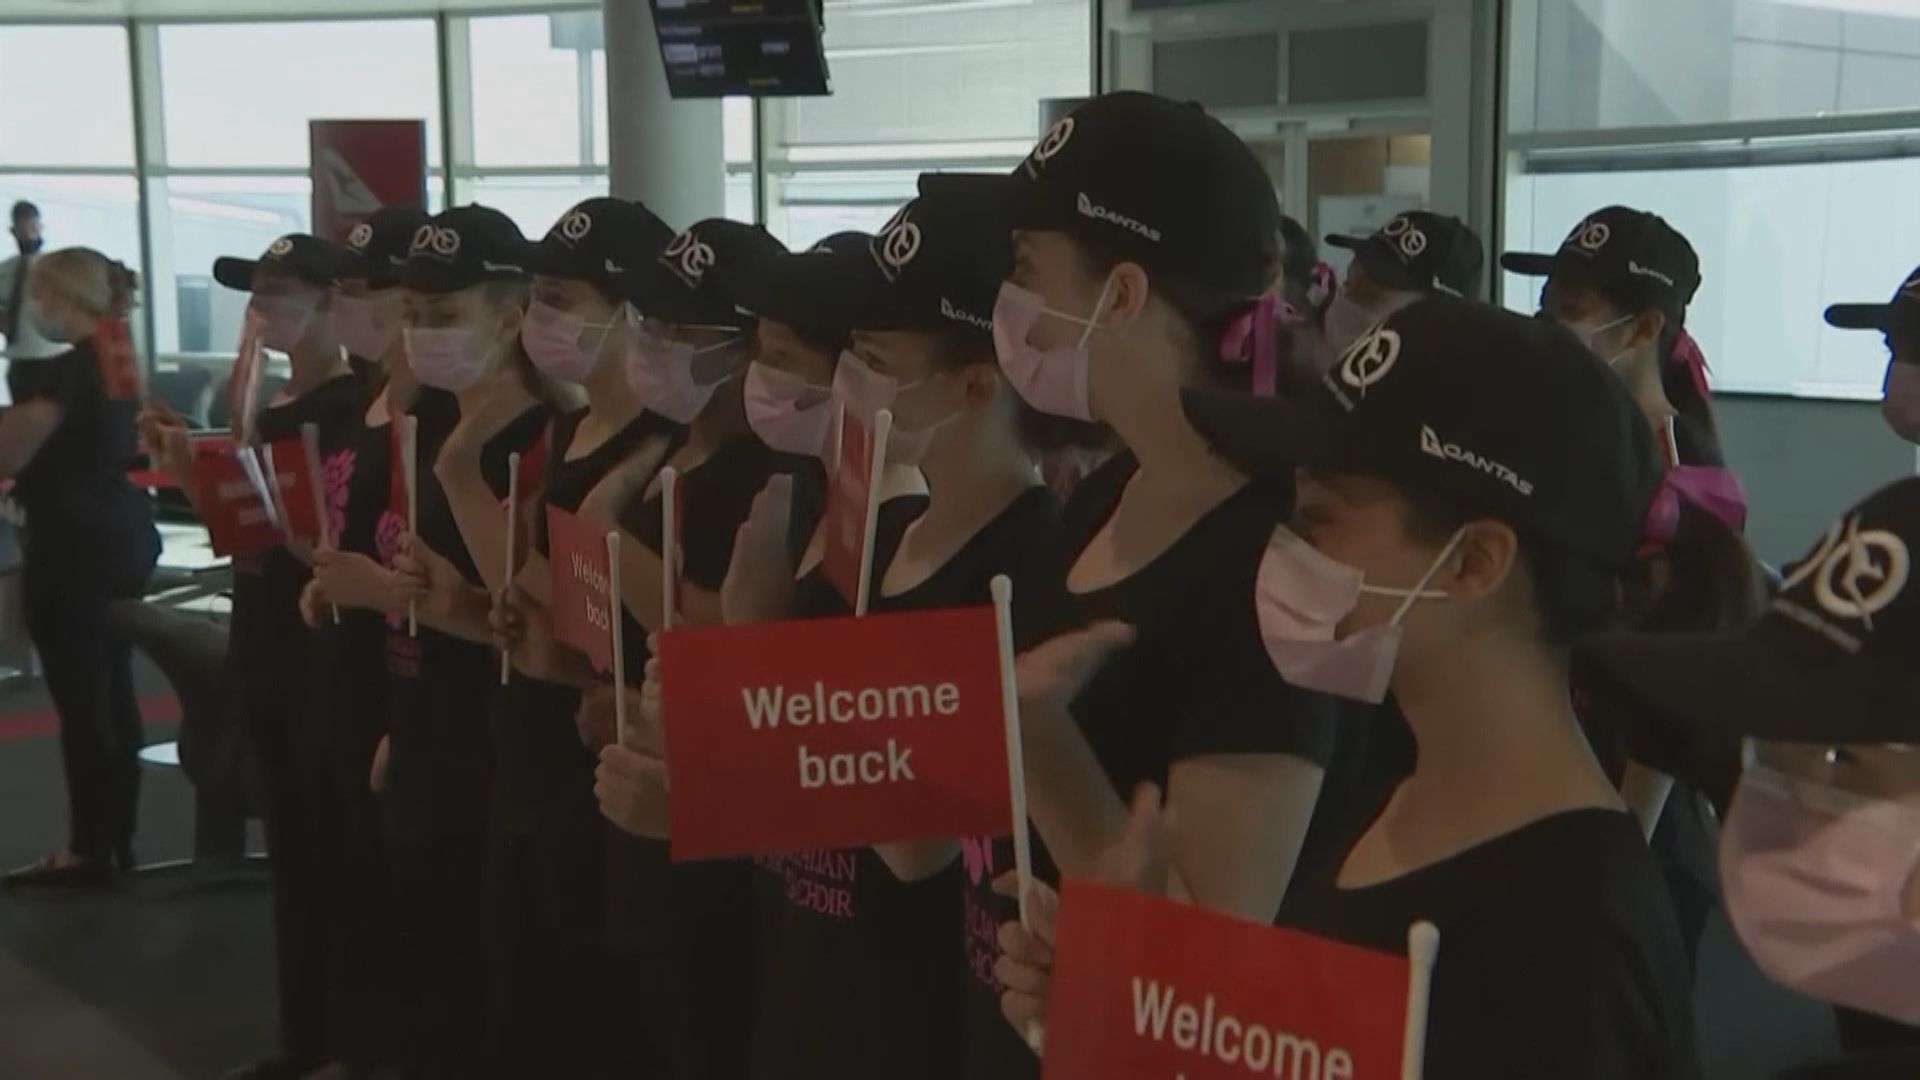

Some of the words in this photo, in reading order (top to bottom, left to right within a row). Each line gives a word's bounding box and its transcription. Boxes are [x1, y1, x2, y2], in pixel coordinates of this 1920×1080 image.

[1094, 205, 1161, 241] QANTAS
[955, 309, 993, 331] QANT
[1443, 442, 1535, 496] QANTAS
[741, 681, 961, 729] Welcome
[798, 738, 916, 788] back
[1131, 975, 1355, 1080] Welcome
